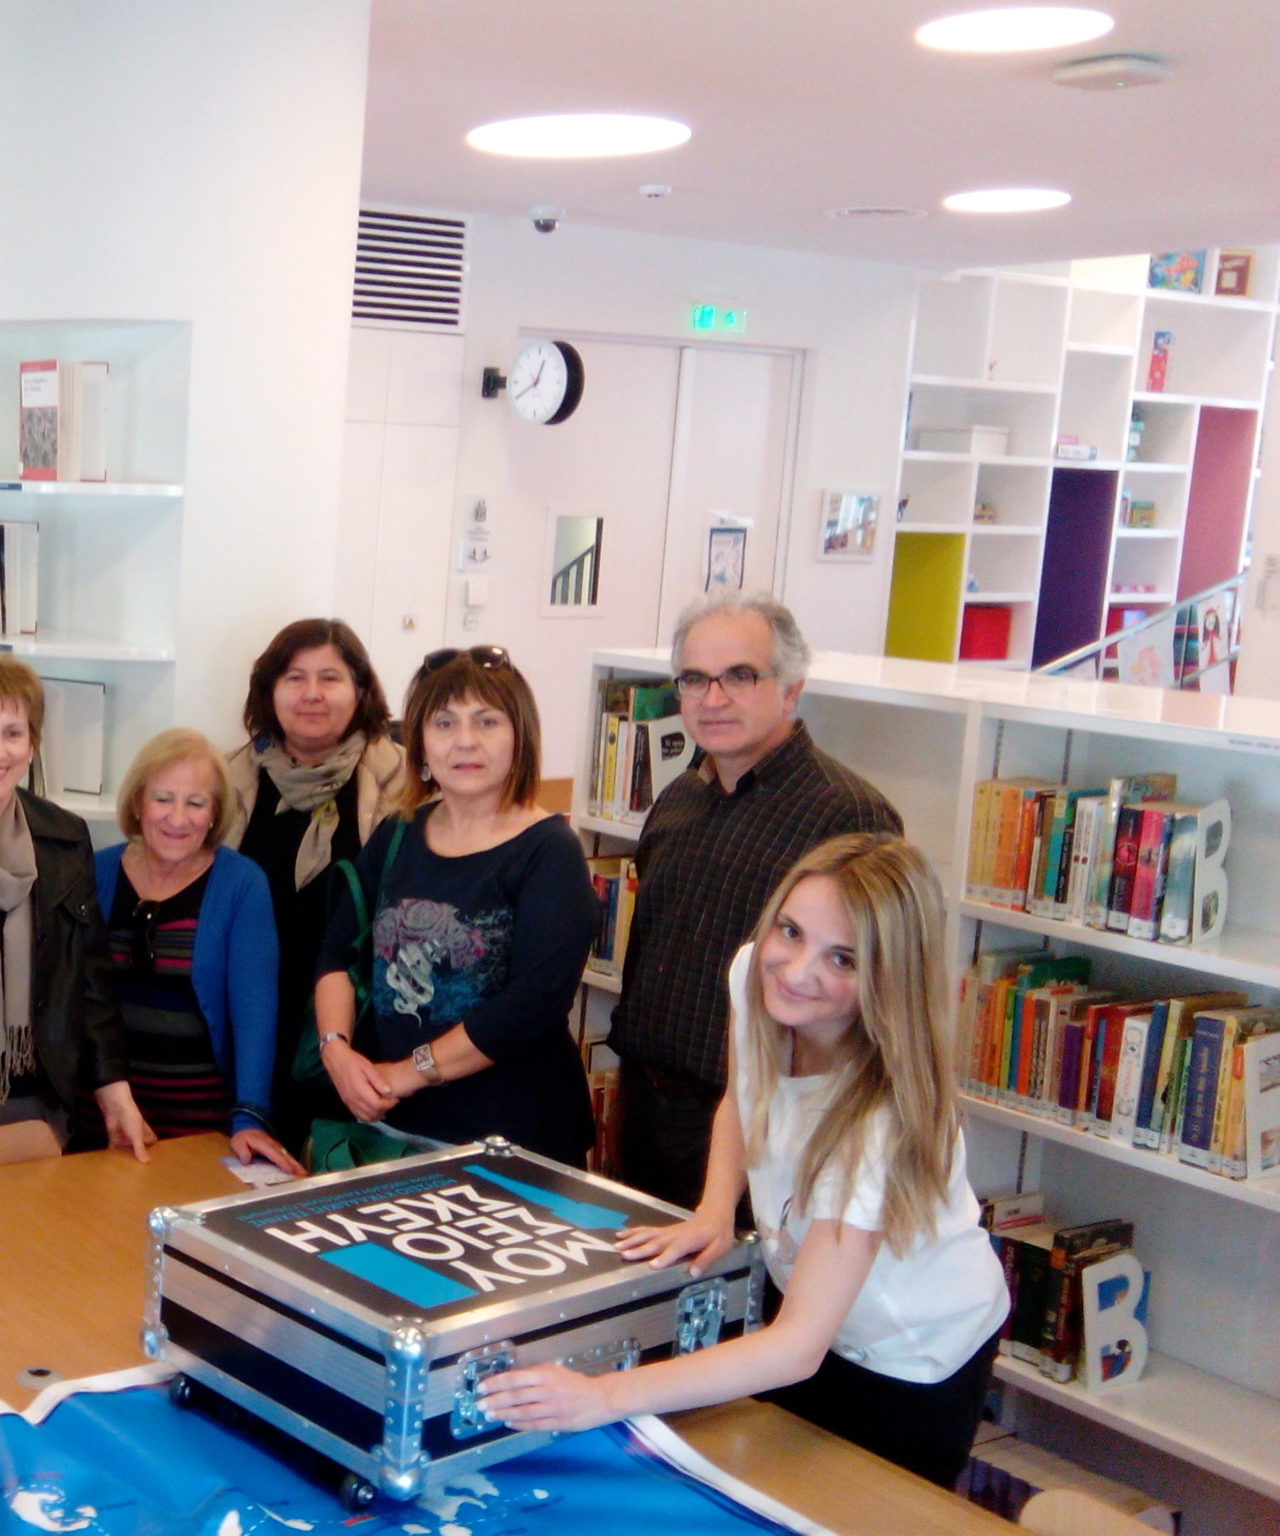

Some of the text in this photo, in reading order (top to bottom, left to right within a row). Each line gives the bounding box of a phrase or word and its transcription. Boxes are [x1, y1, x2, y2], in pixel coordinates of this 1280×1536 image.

[264, 1184, 517, 1255] ΣΚΕΥΗ
[392, 1203, 574, 1261] ΣΕΙΟ
[449, 1227, 623, 1293] ΜΟΥ
